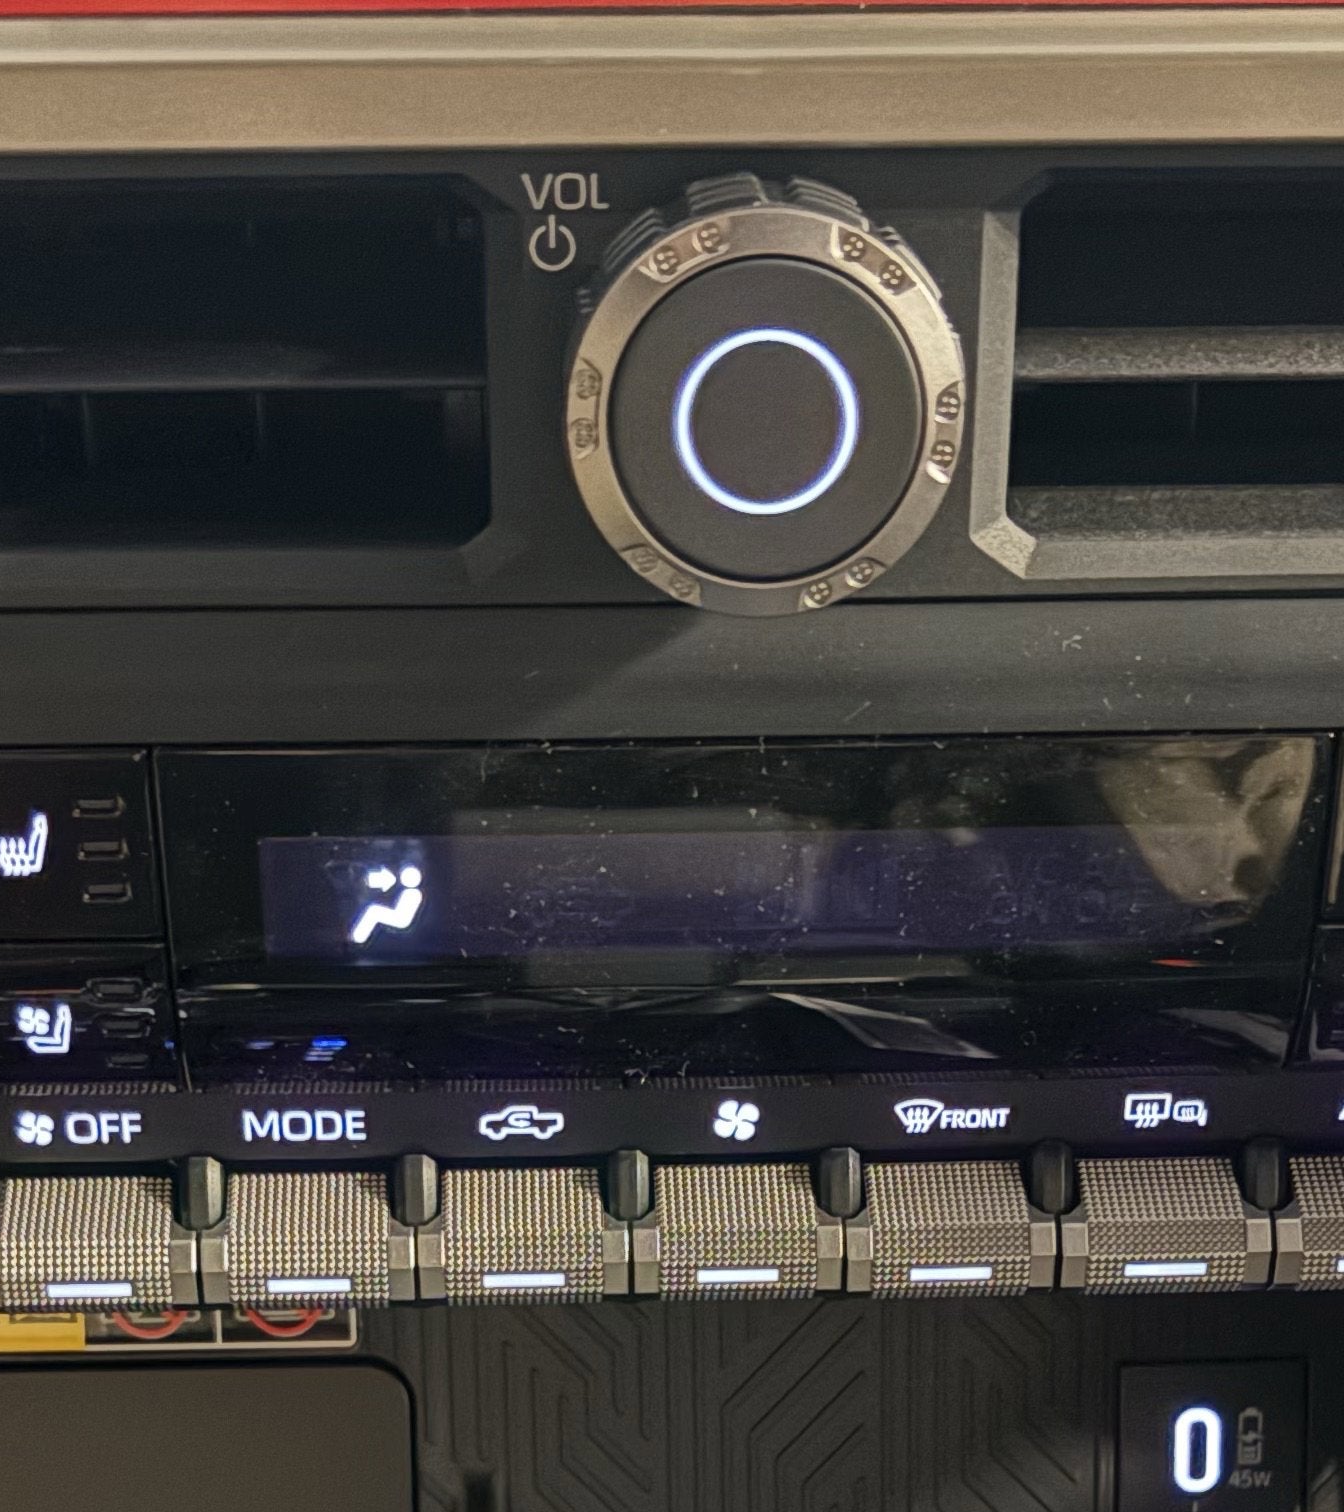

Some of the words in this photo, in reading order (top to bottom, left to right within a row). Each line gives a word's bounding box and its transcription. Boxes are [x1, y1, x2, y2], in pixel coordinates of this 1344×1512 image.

[520, 172, 610, 210] VOL
[64, 1112, 143, 1145] OFF
[242, 1109, 367, 1142] MODE
[940, 1107, 1011, 1130] FRONT
[1173, 1406, 1223, 1494] 0
[1228, 1469, 1272, 1489] 45W
